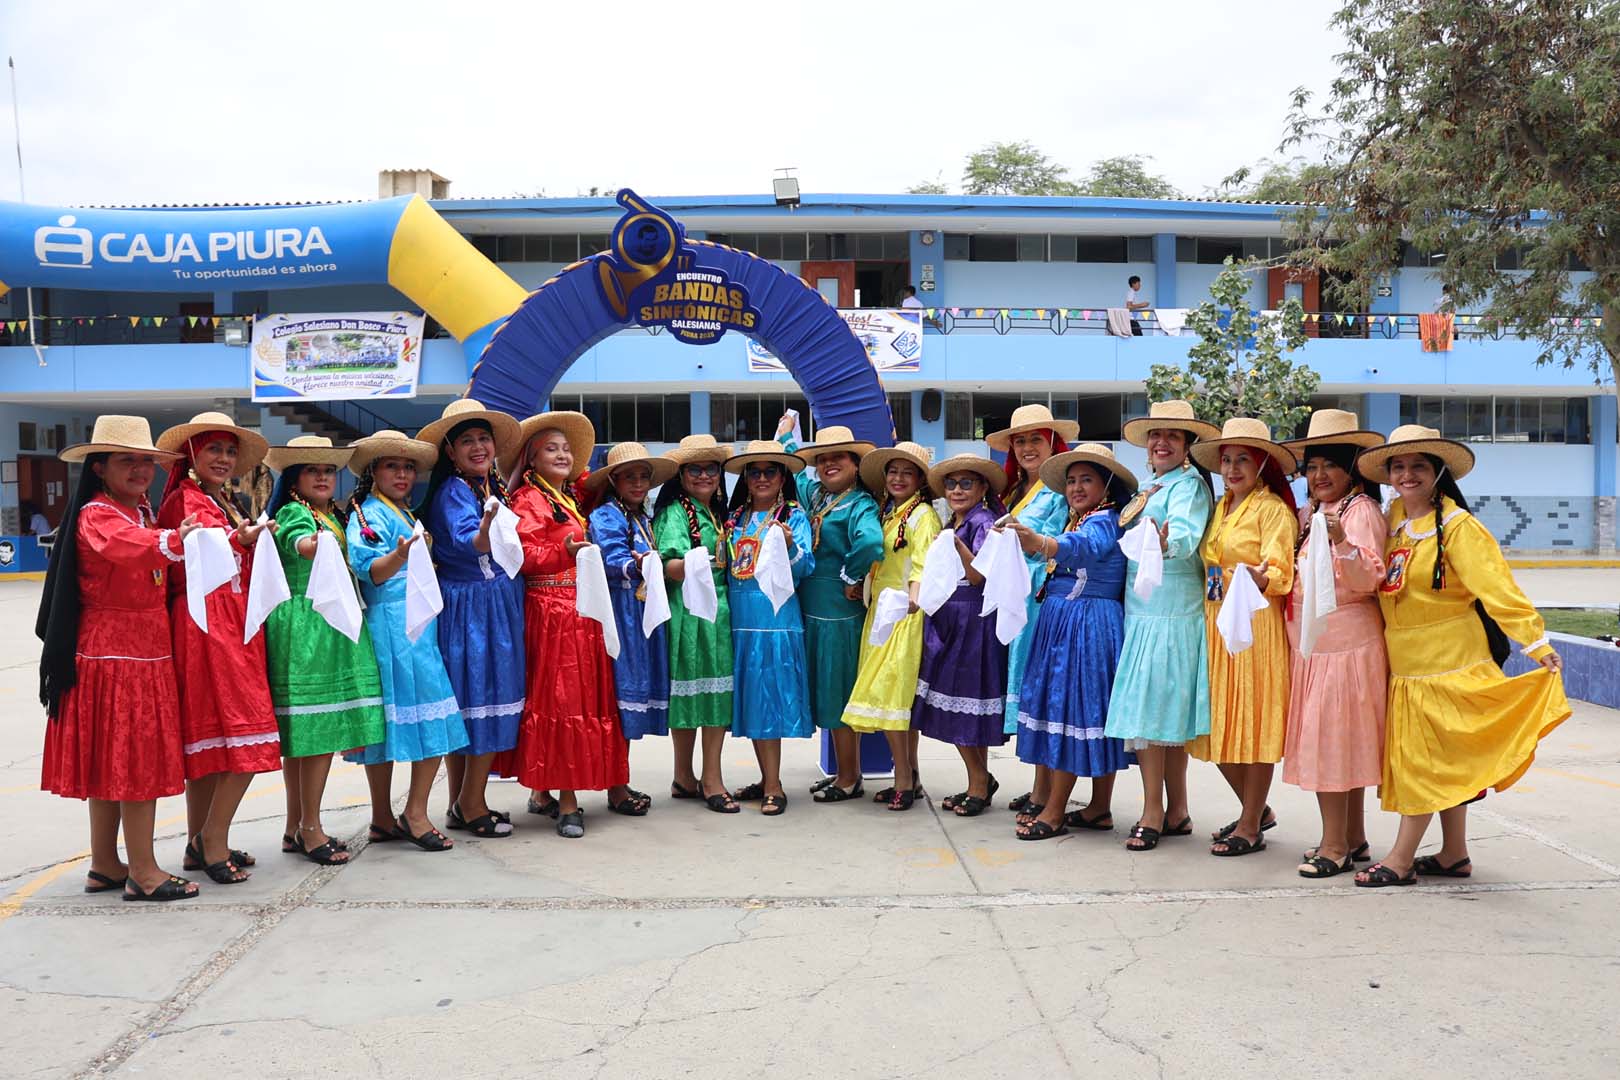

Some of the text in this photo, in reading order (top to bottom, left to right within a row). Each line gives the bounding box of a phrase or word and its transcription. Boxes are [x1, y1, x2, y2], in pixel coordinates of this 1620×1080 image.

[99, 226, 333, 263] CAJA PIURA
[173, 262, 338, 280] Tu oportunidad es ahora
[676, 272, 723, 284] ENCUENTRO
[654, 282, 743, 309] BANDAS
[641, 302, 755, 327] SINFÓNICAS
[275, 324, 303, 337] Colegio
[303, 320, 340, 331] Salesiano
[340, 320, 357, 329] Don
[358, 320, 382, 331] Bosco
[671, 319, 722, 331] SALESIANAS
